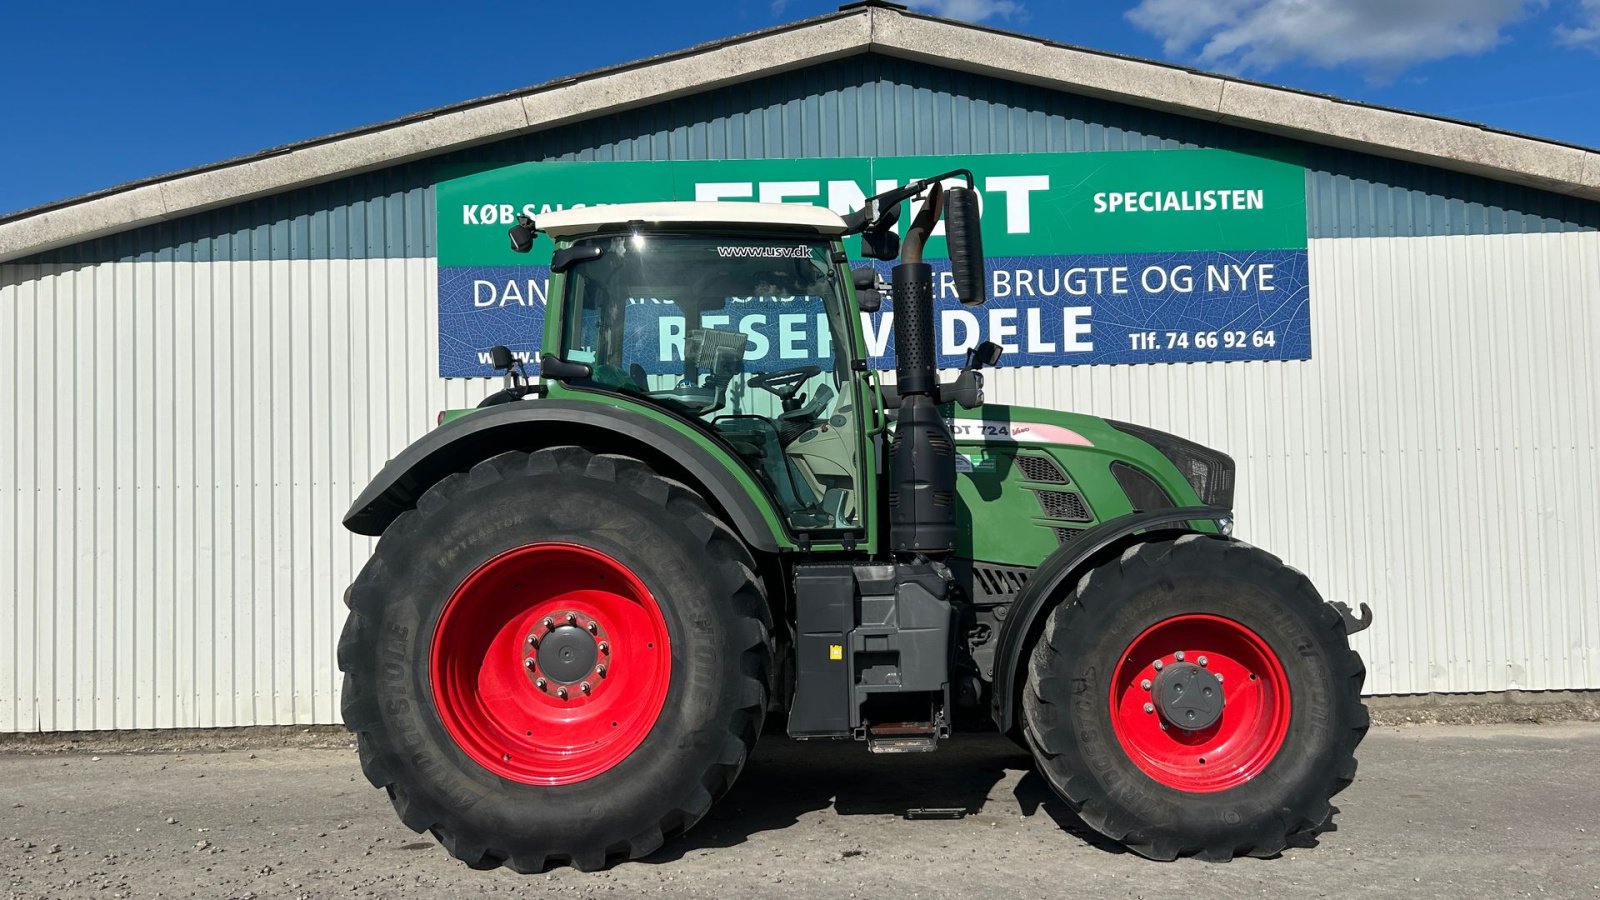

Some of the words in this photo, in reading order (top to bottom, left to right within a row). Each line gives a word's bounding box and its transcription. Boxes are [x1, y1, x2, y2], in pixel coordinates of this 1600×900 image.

[1093, 189, 1264, 213] SPECIALISTEN
[717, 244, 813, 259] www.usv.dk
[993, 266, 1128, 297] BRUGTE
[1141, 264, 1193, 293] OG
[1207, 263, 1275, 291] NYE
[1128, 332, 1161, 350] Tlf.
[1165, 331, 1189, 349] 74
[1194, 331, 1218, 349] 66
[1223, 330, 1247, 348] 92
[1252, 329, 1276, 348] 64
[977, 425, 1009, 436] 724
